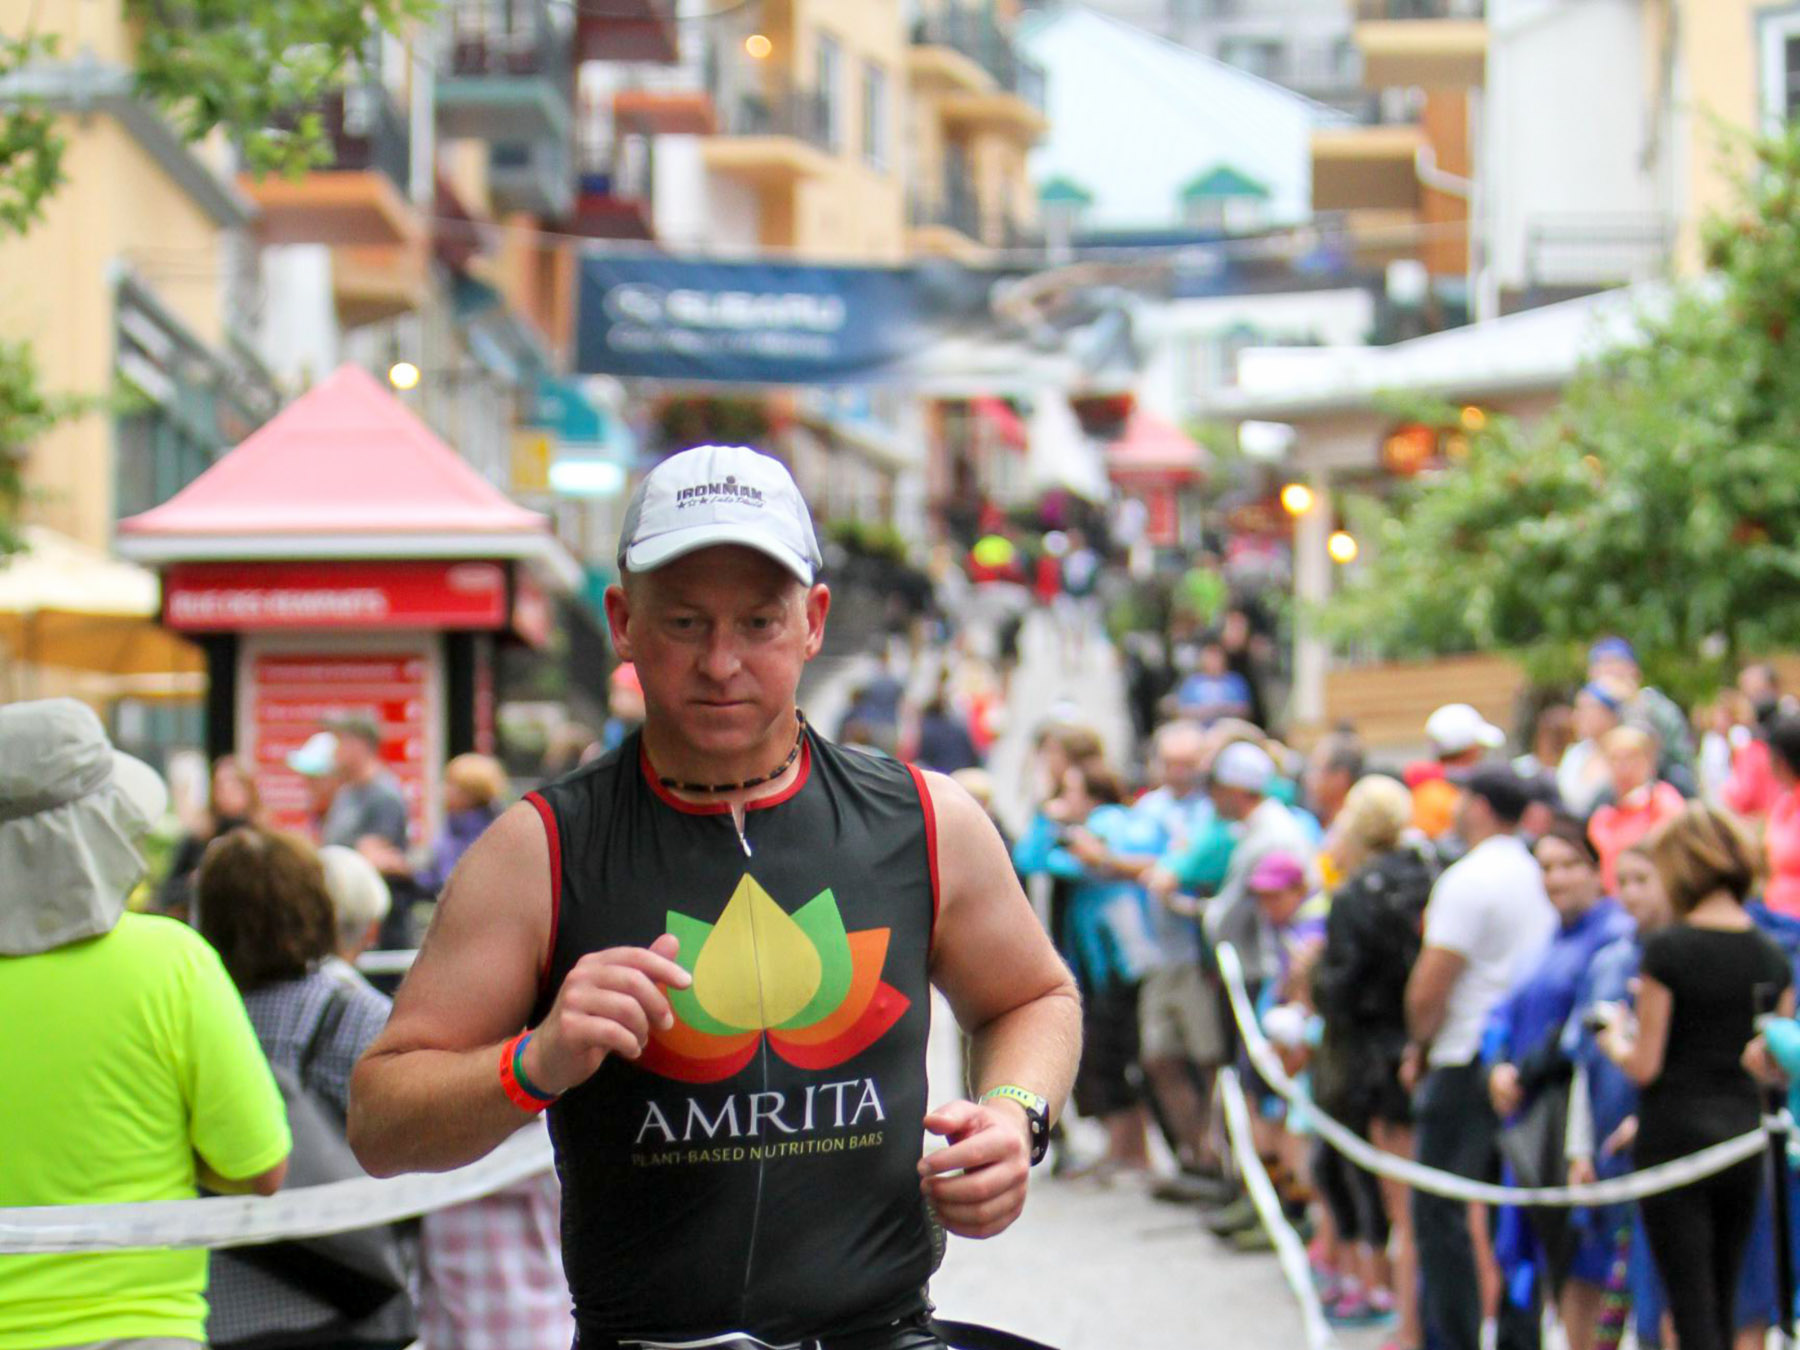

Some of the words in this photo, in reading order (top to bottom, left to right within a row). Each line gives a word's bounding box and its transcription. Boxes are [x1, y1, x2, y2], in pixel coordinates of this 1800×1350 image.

[676, 476, 763, 502] IRONMAN
[635, 1077, 886, 1145] AMRITA
[632, 1146, 745, 1167] PLANT-BASED
[749, 1137, 845, 1160] NUTRITION
[849, 1130, 884, 1150] BARS
